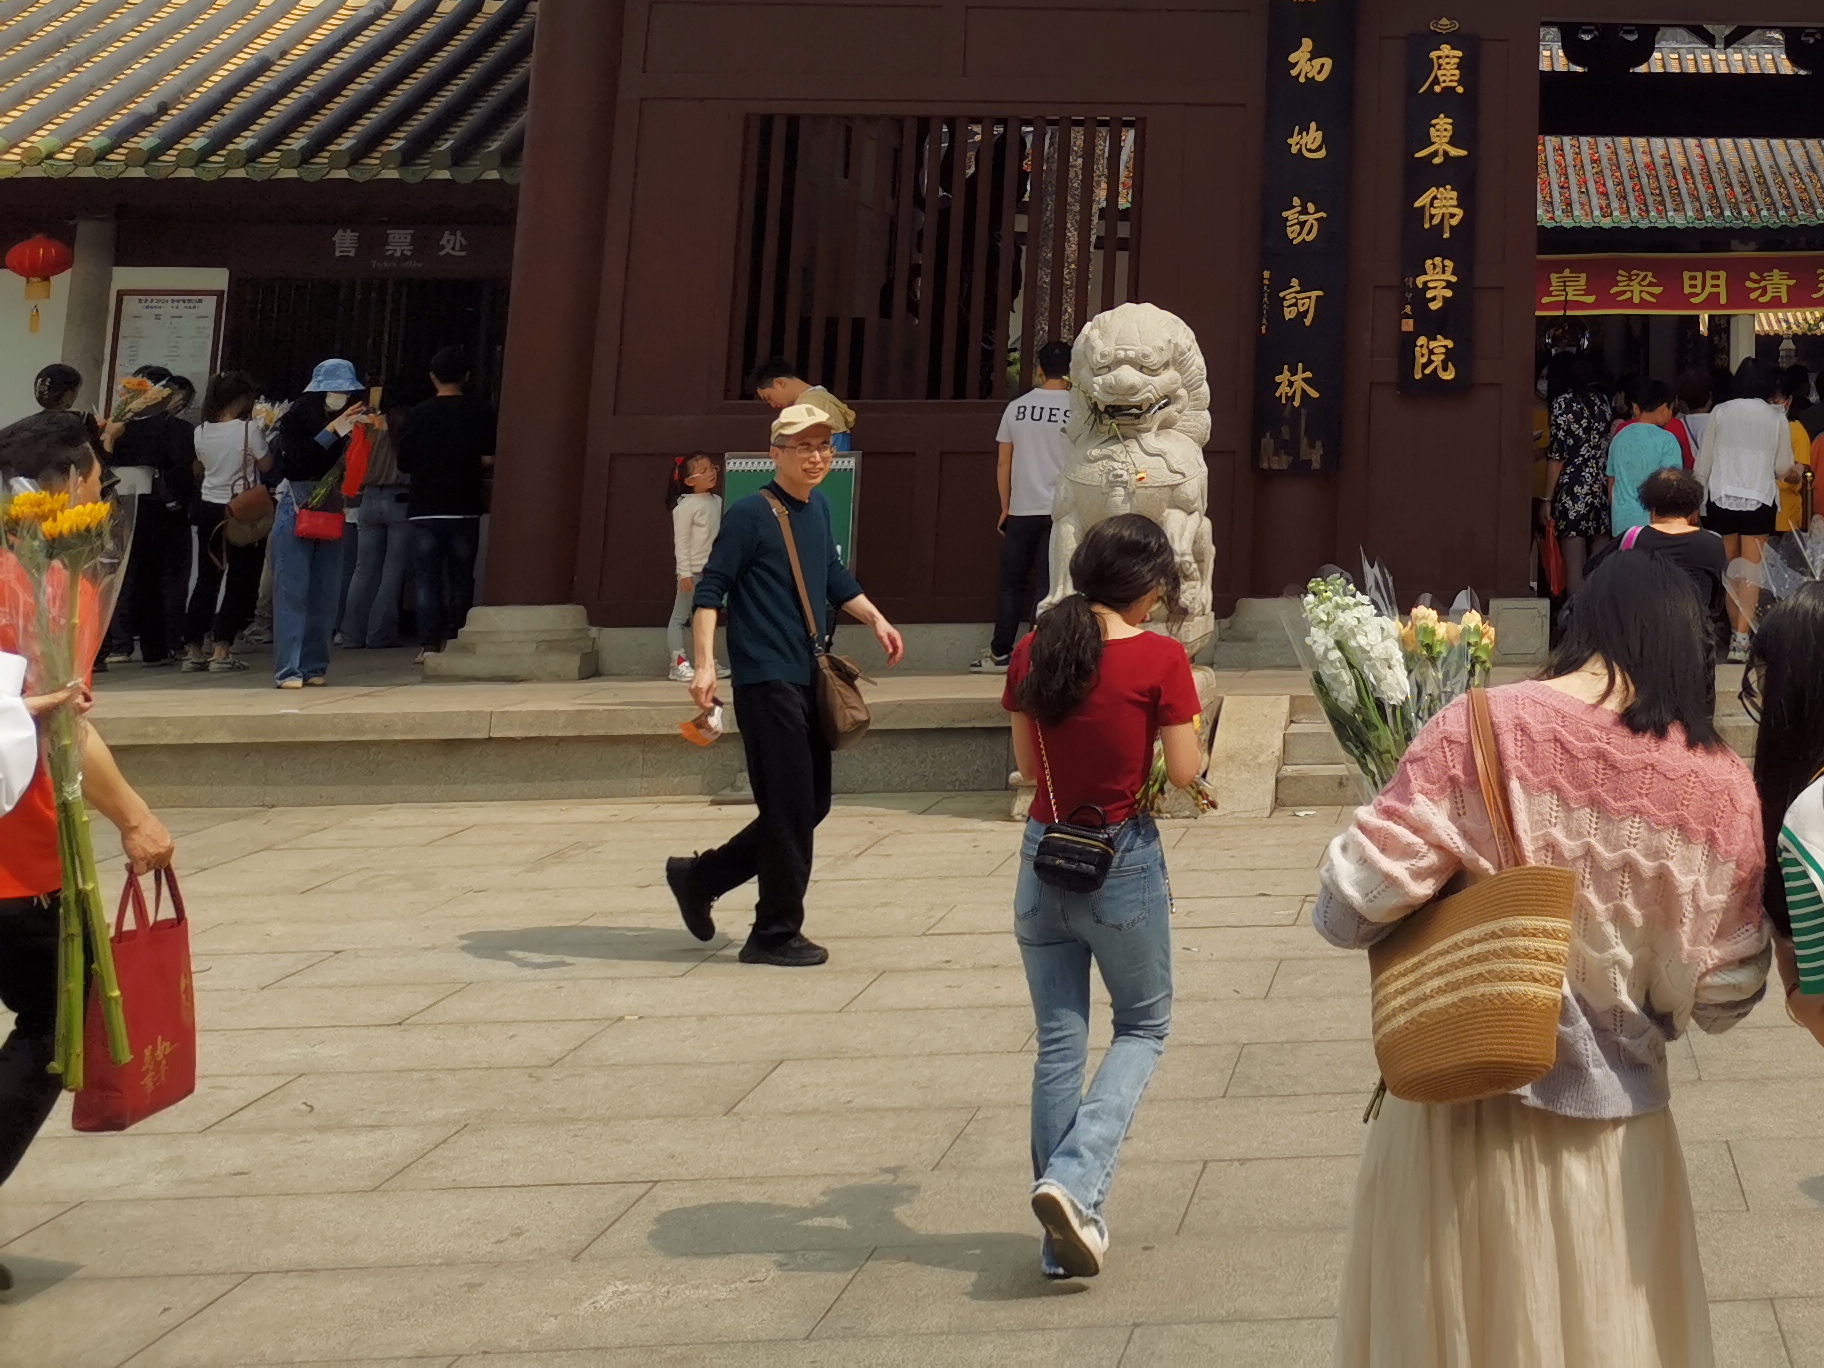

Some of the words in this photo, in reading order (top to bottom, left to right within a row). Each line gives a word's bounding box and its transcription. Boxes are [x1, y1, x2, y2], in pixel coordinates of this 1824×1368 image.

[331, 228, 468, 258] 售票处
[1274, 37, 1333, 408] 初地訪訶林
[1413, 43, 1468, 380] 廣東佛學院
